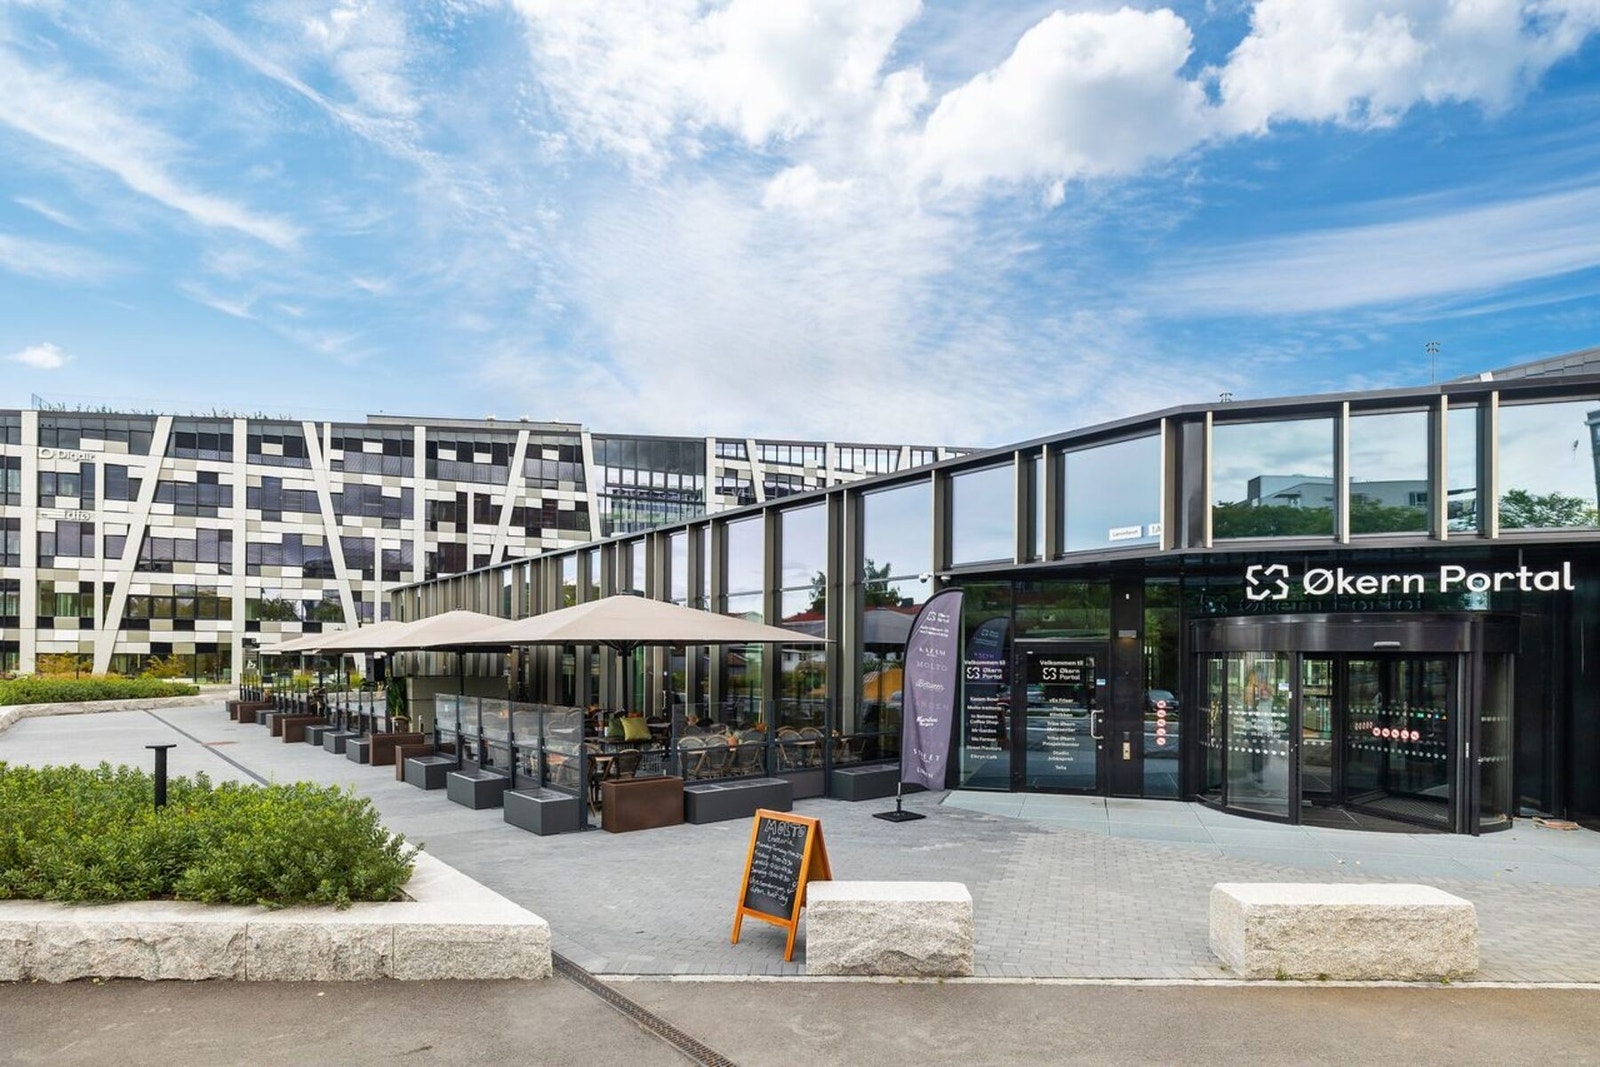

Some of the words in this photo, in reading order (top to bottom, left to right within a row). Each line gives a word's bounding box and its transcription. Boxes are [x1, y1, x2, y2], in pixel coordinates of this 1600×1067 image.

[1303, 567, 1425, 595] Økern
[1440, 561, 1575, 593] Portal
[917, 661, 948, 671] MOLTO
[764, 819, 806, 838] MOLTO
